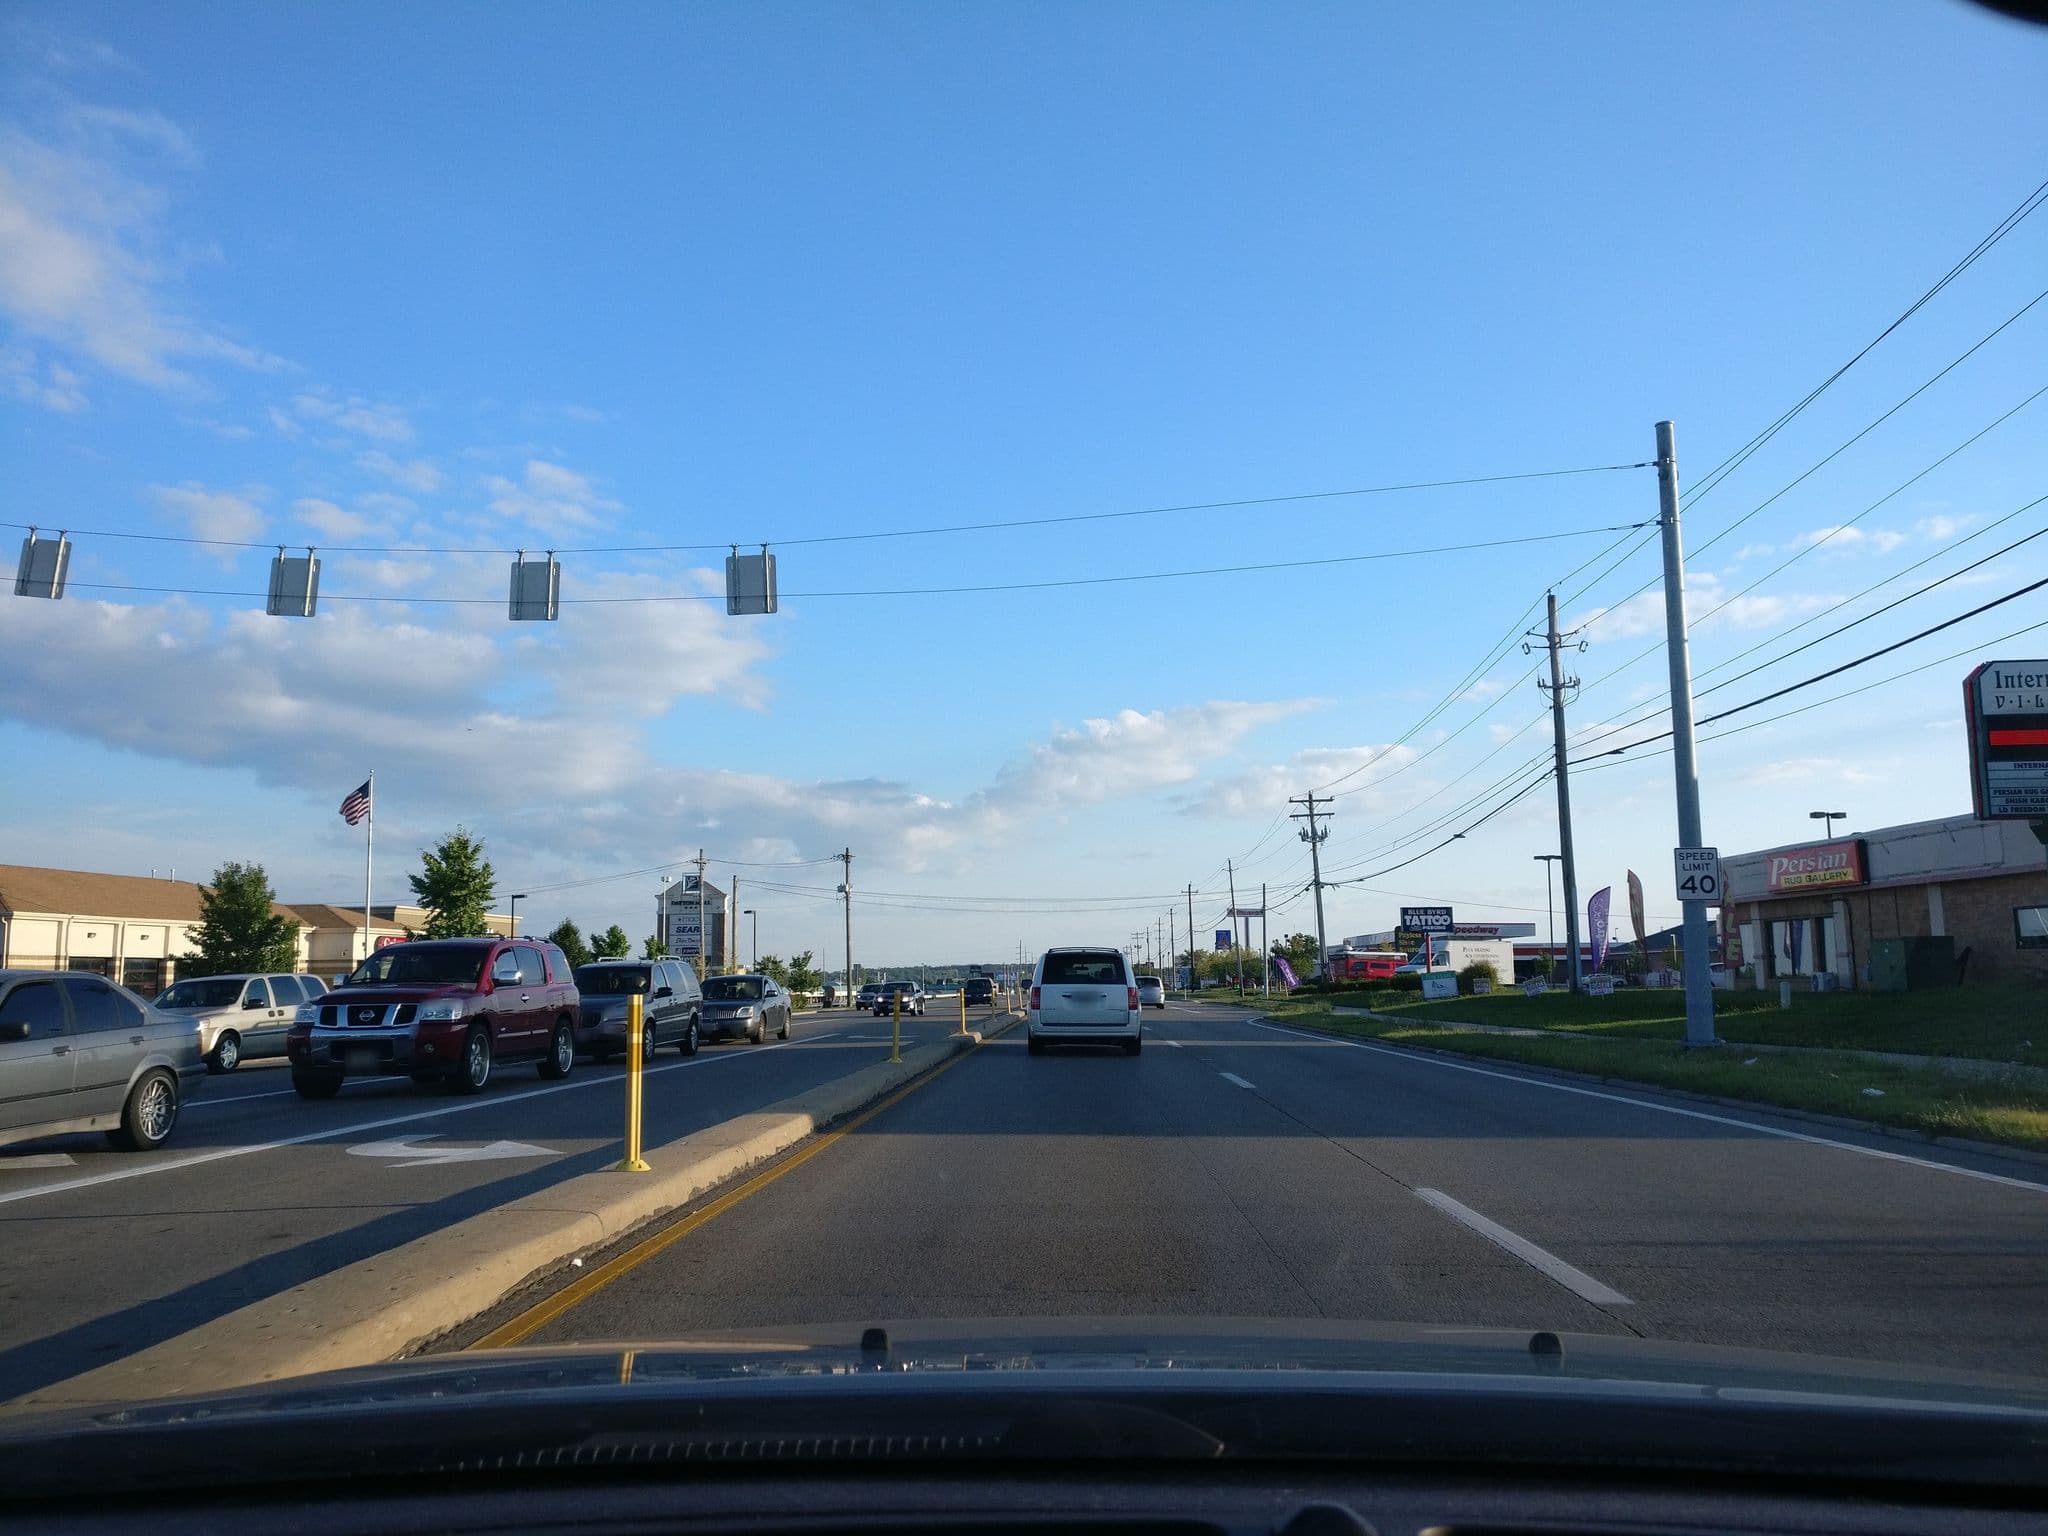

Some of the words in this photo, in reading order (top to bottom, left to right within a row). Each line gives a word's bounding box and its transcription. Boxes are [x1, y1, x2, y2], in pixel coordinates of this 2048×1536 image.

[1679, 852, 1714, 861] SPEED
[1682, 863, 1711, 871] LIMIT
[1770, 852, 1847, 886] Persian
[1784, 875, 1802, 885] RUG
[1805, 870, 1849, 883] GALLERY
[1680, 875, 1716, 894] 40
[1403, 915, 1451, 926] TATTOO
